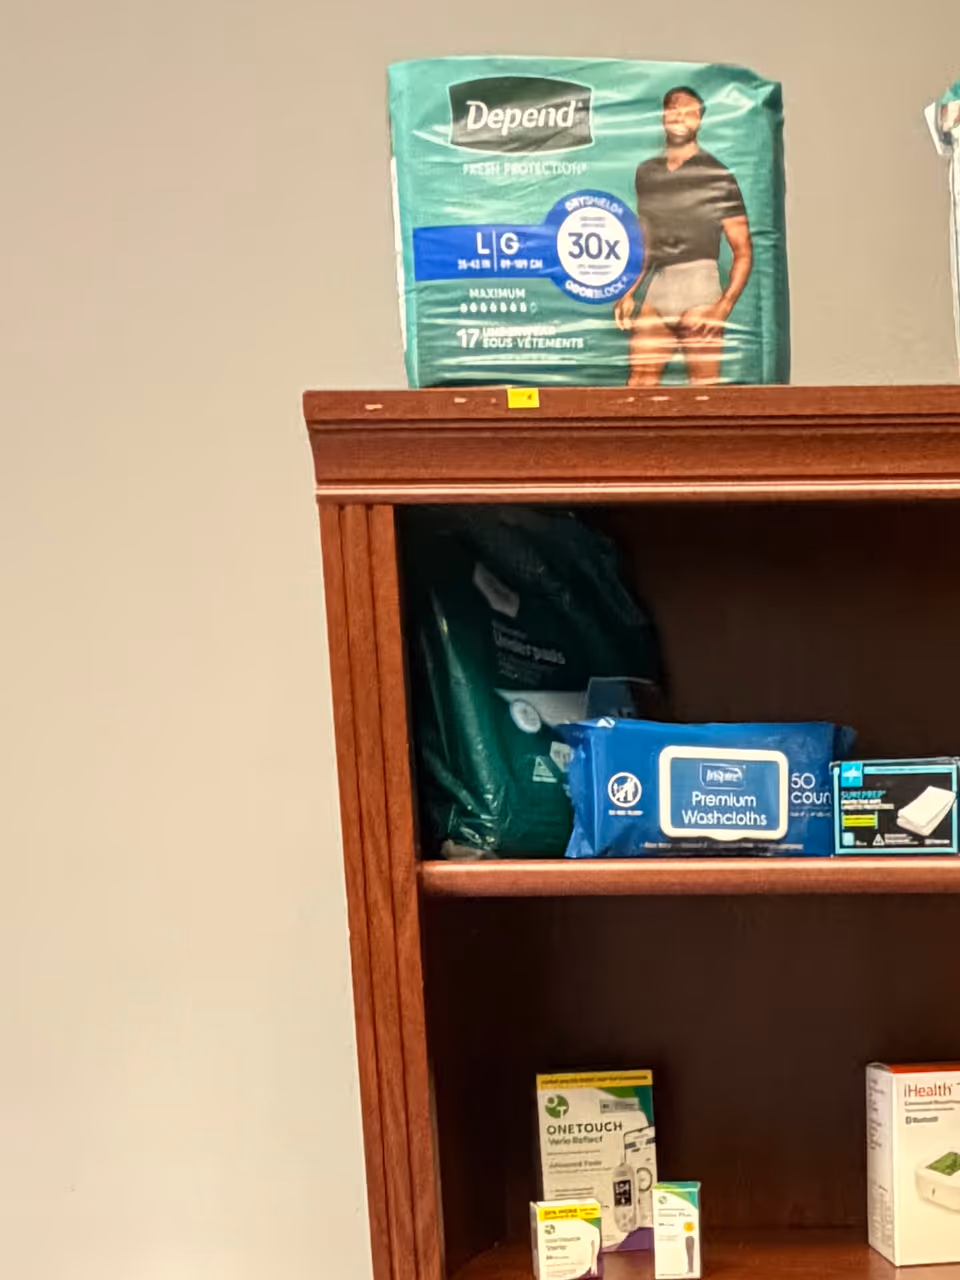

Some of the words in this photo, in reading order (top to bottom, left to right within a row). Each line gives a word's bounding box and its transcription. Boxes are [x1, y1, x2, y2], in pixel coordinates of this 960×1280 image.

[466, 99, 576, 136] Depend
[463, 162, 499, 176] FRESH
[568, 232, 621, 260] 30x
[469, 288, 526, 299] MAXIMUM
[456, 328, 480, 348] 17
[791, 772, 816, 789] 50
[692, 791, 757, 807] Premium
[681, 810, 768, 826] Washcloths
[904, 1082, 952, 1098] iHealth
